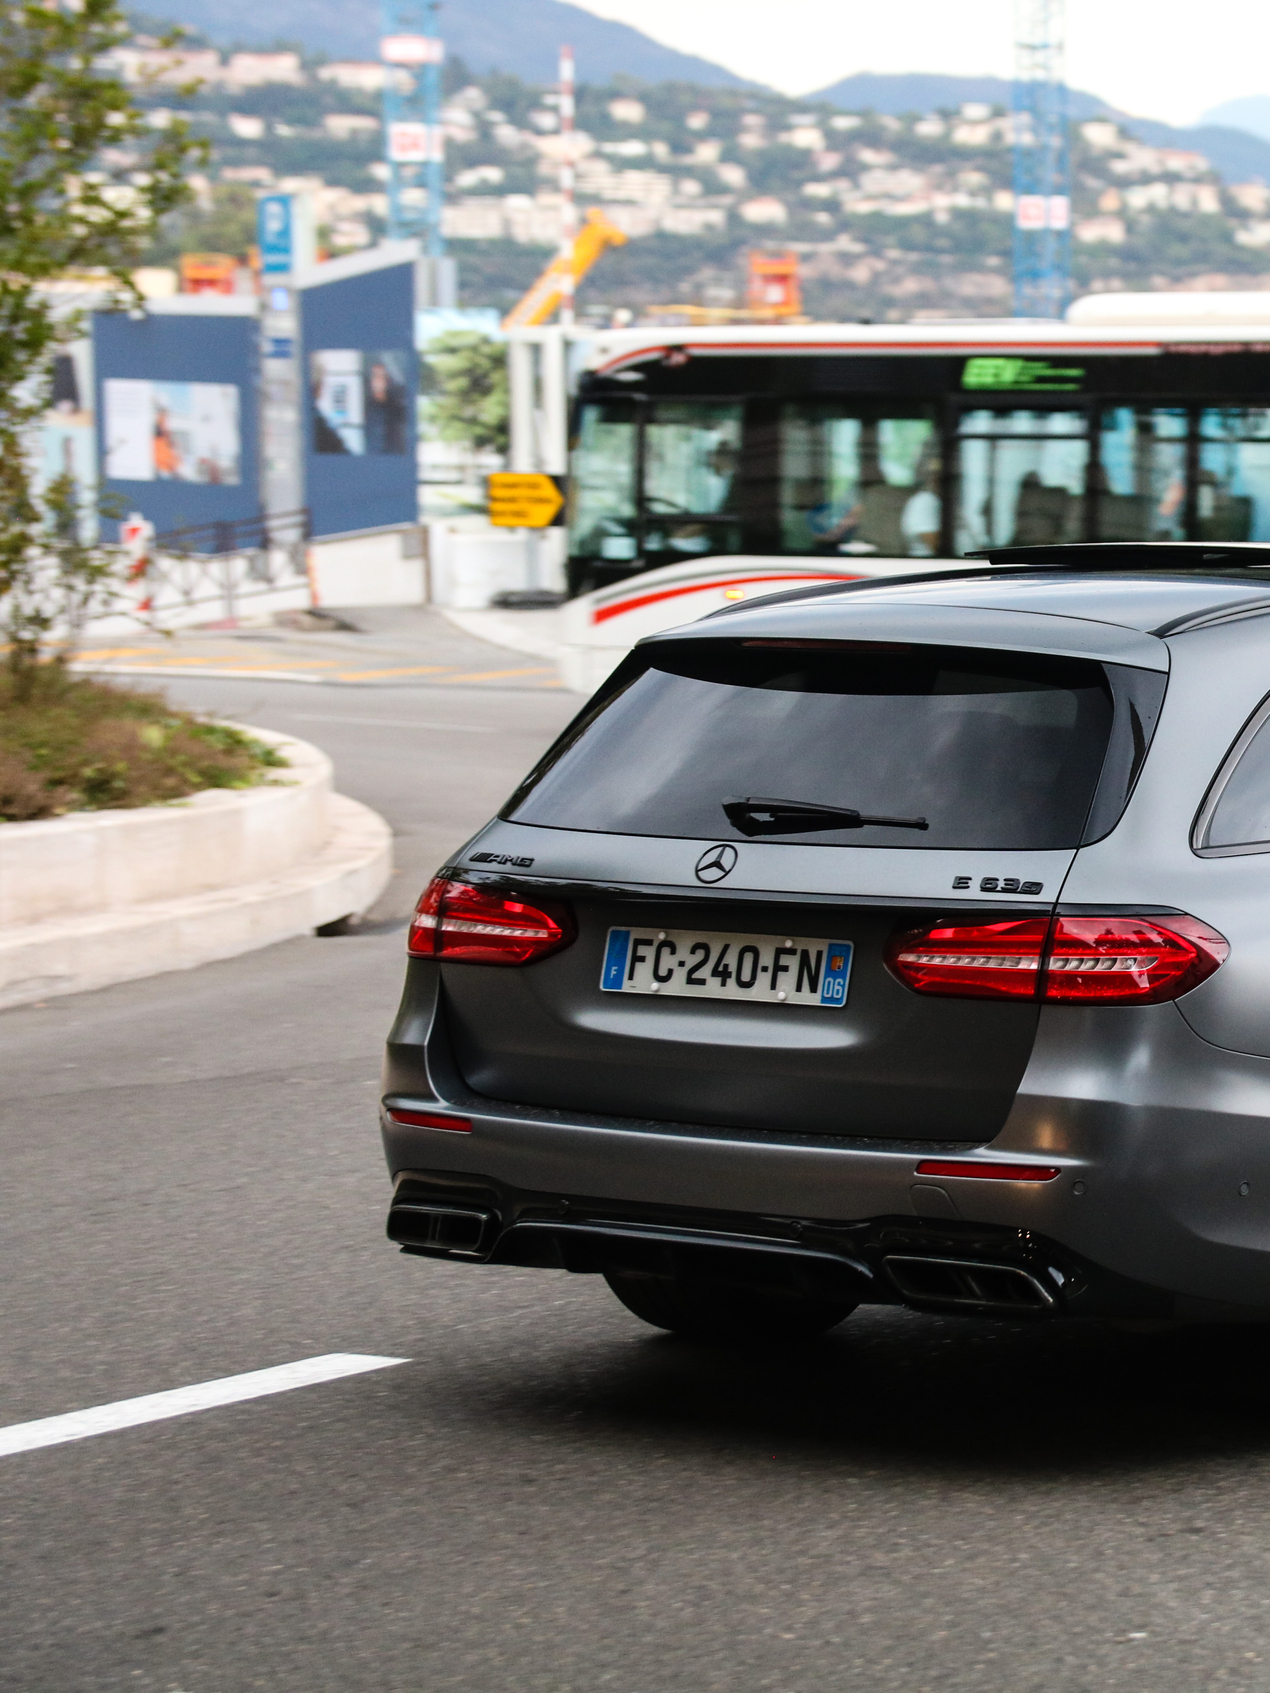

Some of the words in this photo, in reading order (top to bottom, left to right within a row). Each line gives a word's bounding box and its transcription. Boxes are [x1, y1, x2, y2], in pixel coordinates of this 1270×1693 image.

[952, 875, 973, 890] E
[610, 966, 618, 979] F
[823, 977, 844, 999] 06
